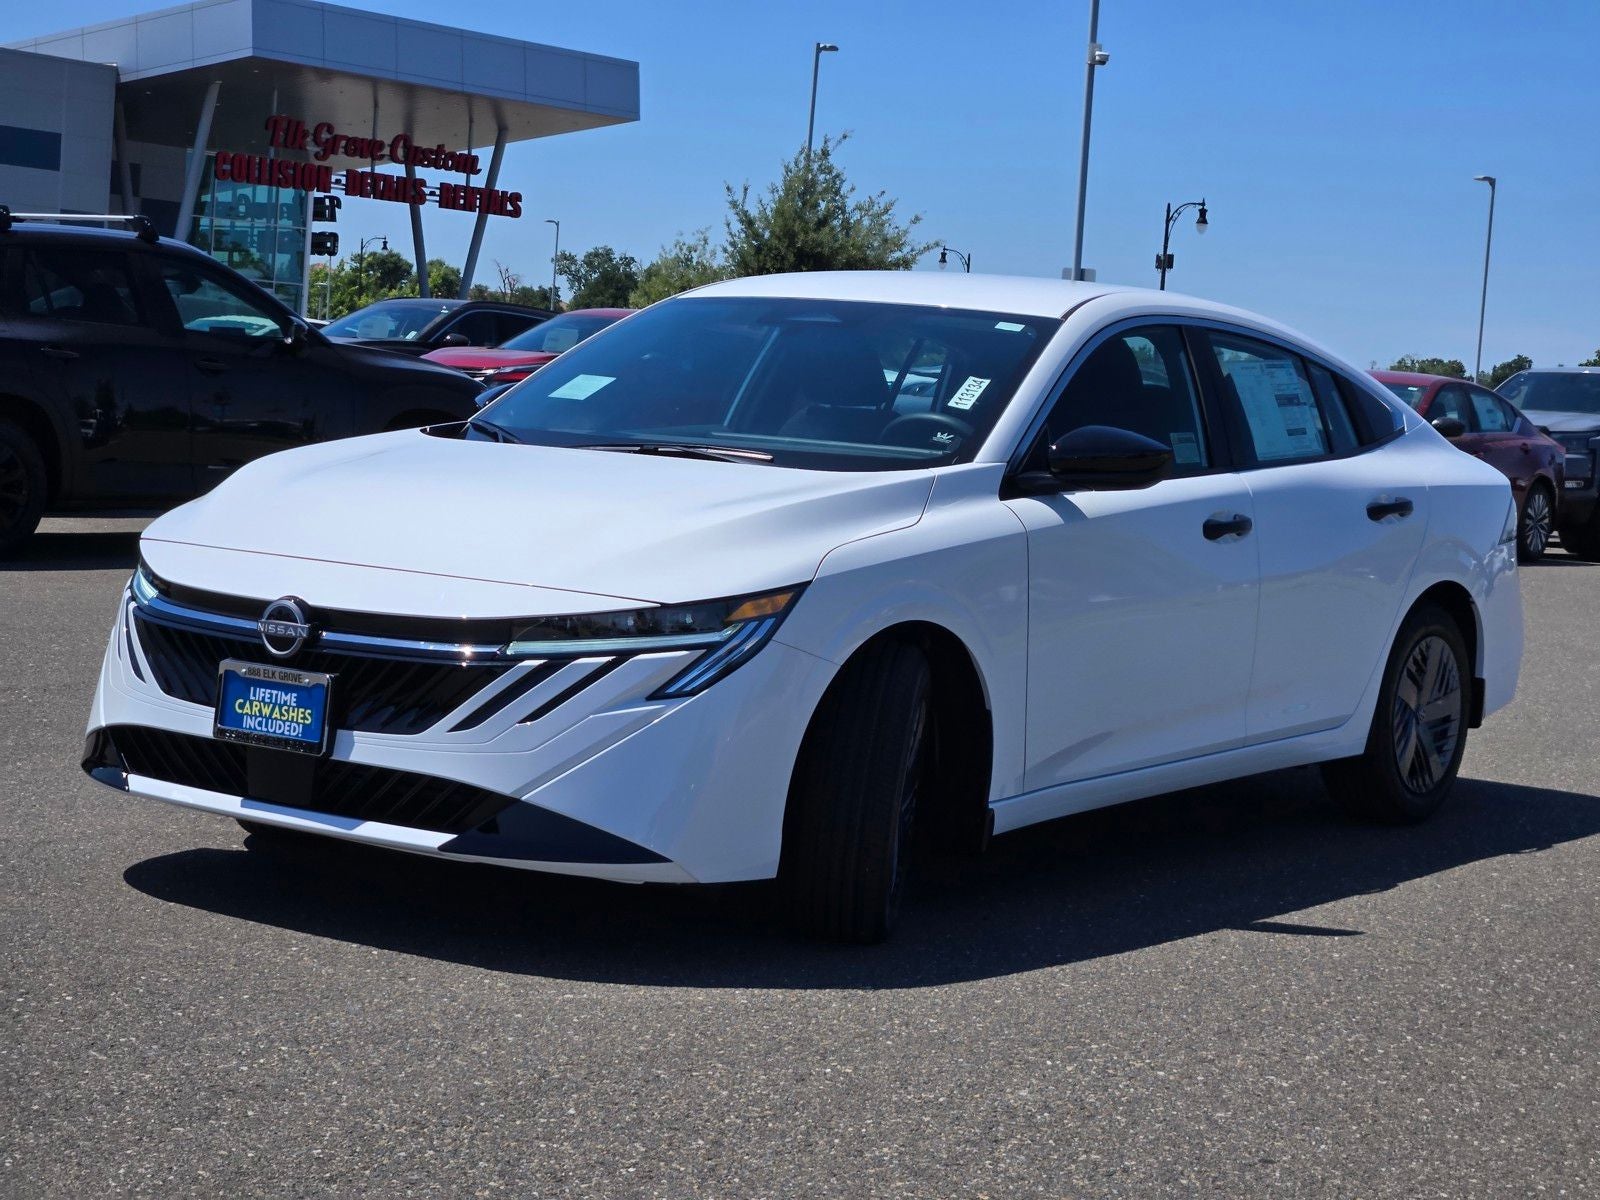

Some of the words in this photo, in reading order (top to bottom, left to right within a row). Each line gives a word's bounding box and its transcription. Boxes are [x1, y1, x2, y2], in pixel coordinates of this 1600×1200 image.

[265, 115, 309, 150] Elk
[313, 122, 386, 161] Grove
[390, 134, 482, 175] Custom
[215, 151, 332, 193] COLLISION
[345, 169, 427, 205] DETAILS
[439, 182, 522, 218] RENTALS
[954, 378, 986, 406] 113134
[257, 622, 308, 638] NISSAN
[262, 669, 277, 680] ELK
[278, 671, 303, 684] GROVE
[249, 686, 298, 707] LIFETIME
[235, 698, 312, 725] CARWASHES
[242, 714, 303, 738] INCLUDED!
